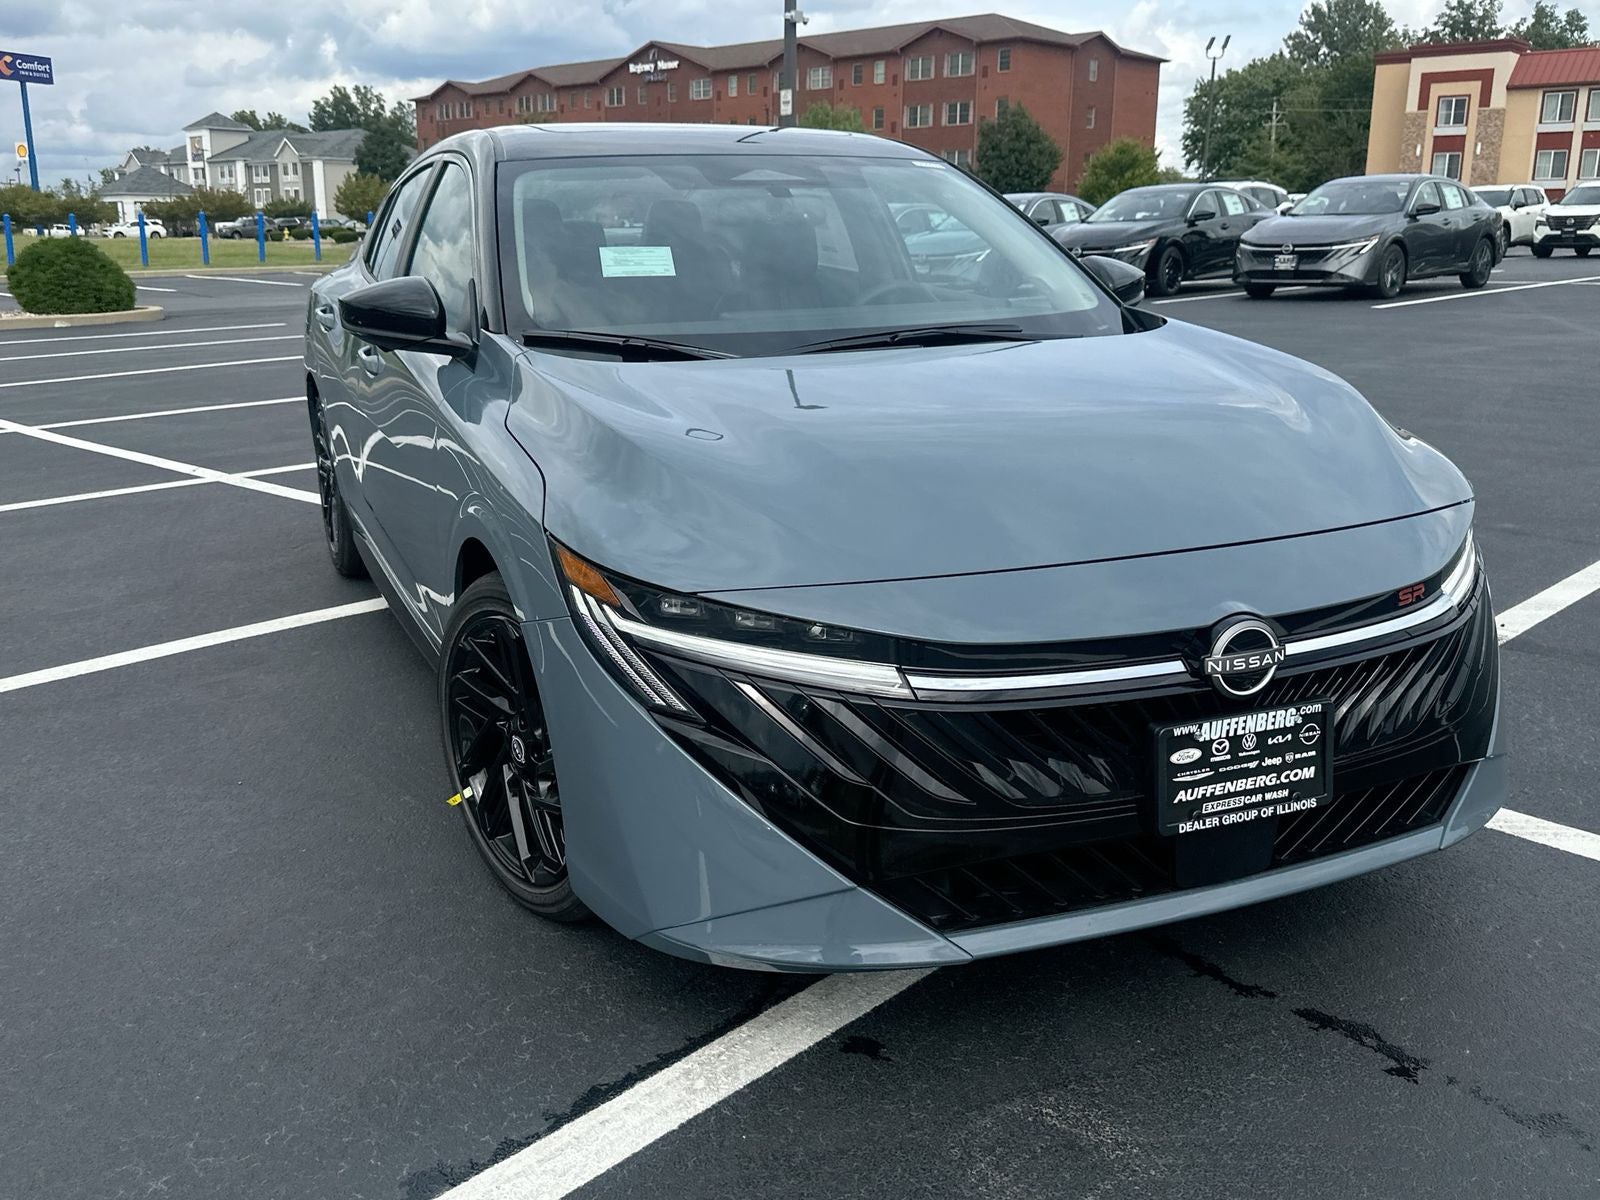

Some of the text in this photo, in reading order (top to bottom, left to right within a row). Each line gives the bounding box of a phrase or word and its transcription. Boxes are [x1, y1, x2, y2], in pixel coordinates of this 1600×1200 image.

[16, 59, 50, 72] Comfort
[1397, 583, 1425, 606] SR
[1207, 649, 1286, 673] NISSAN
[1261, 756, 1282, 766] Jeep
[1173, 766, 1316, 804] AUFFENBERG.COM
[1203, 788, 1289, 812] EXPRESS CAR WASH
[1178, 798, 1317, 834] DEALER GROUP OF ILLINOIS
